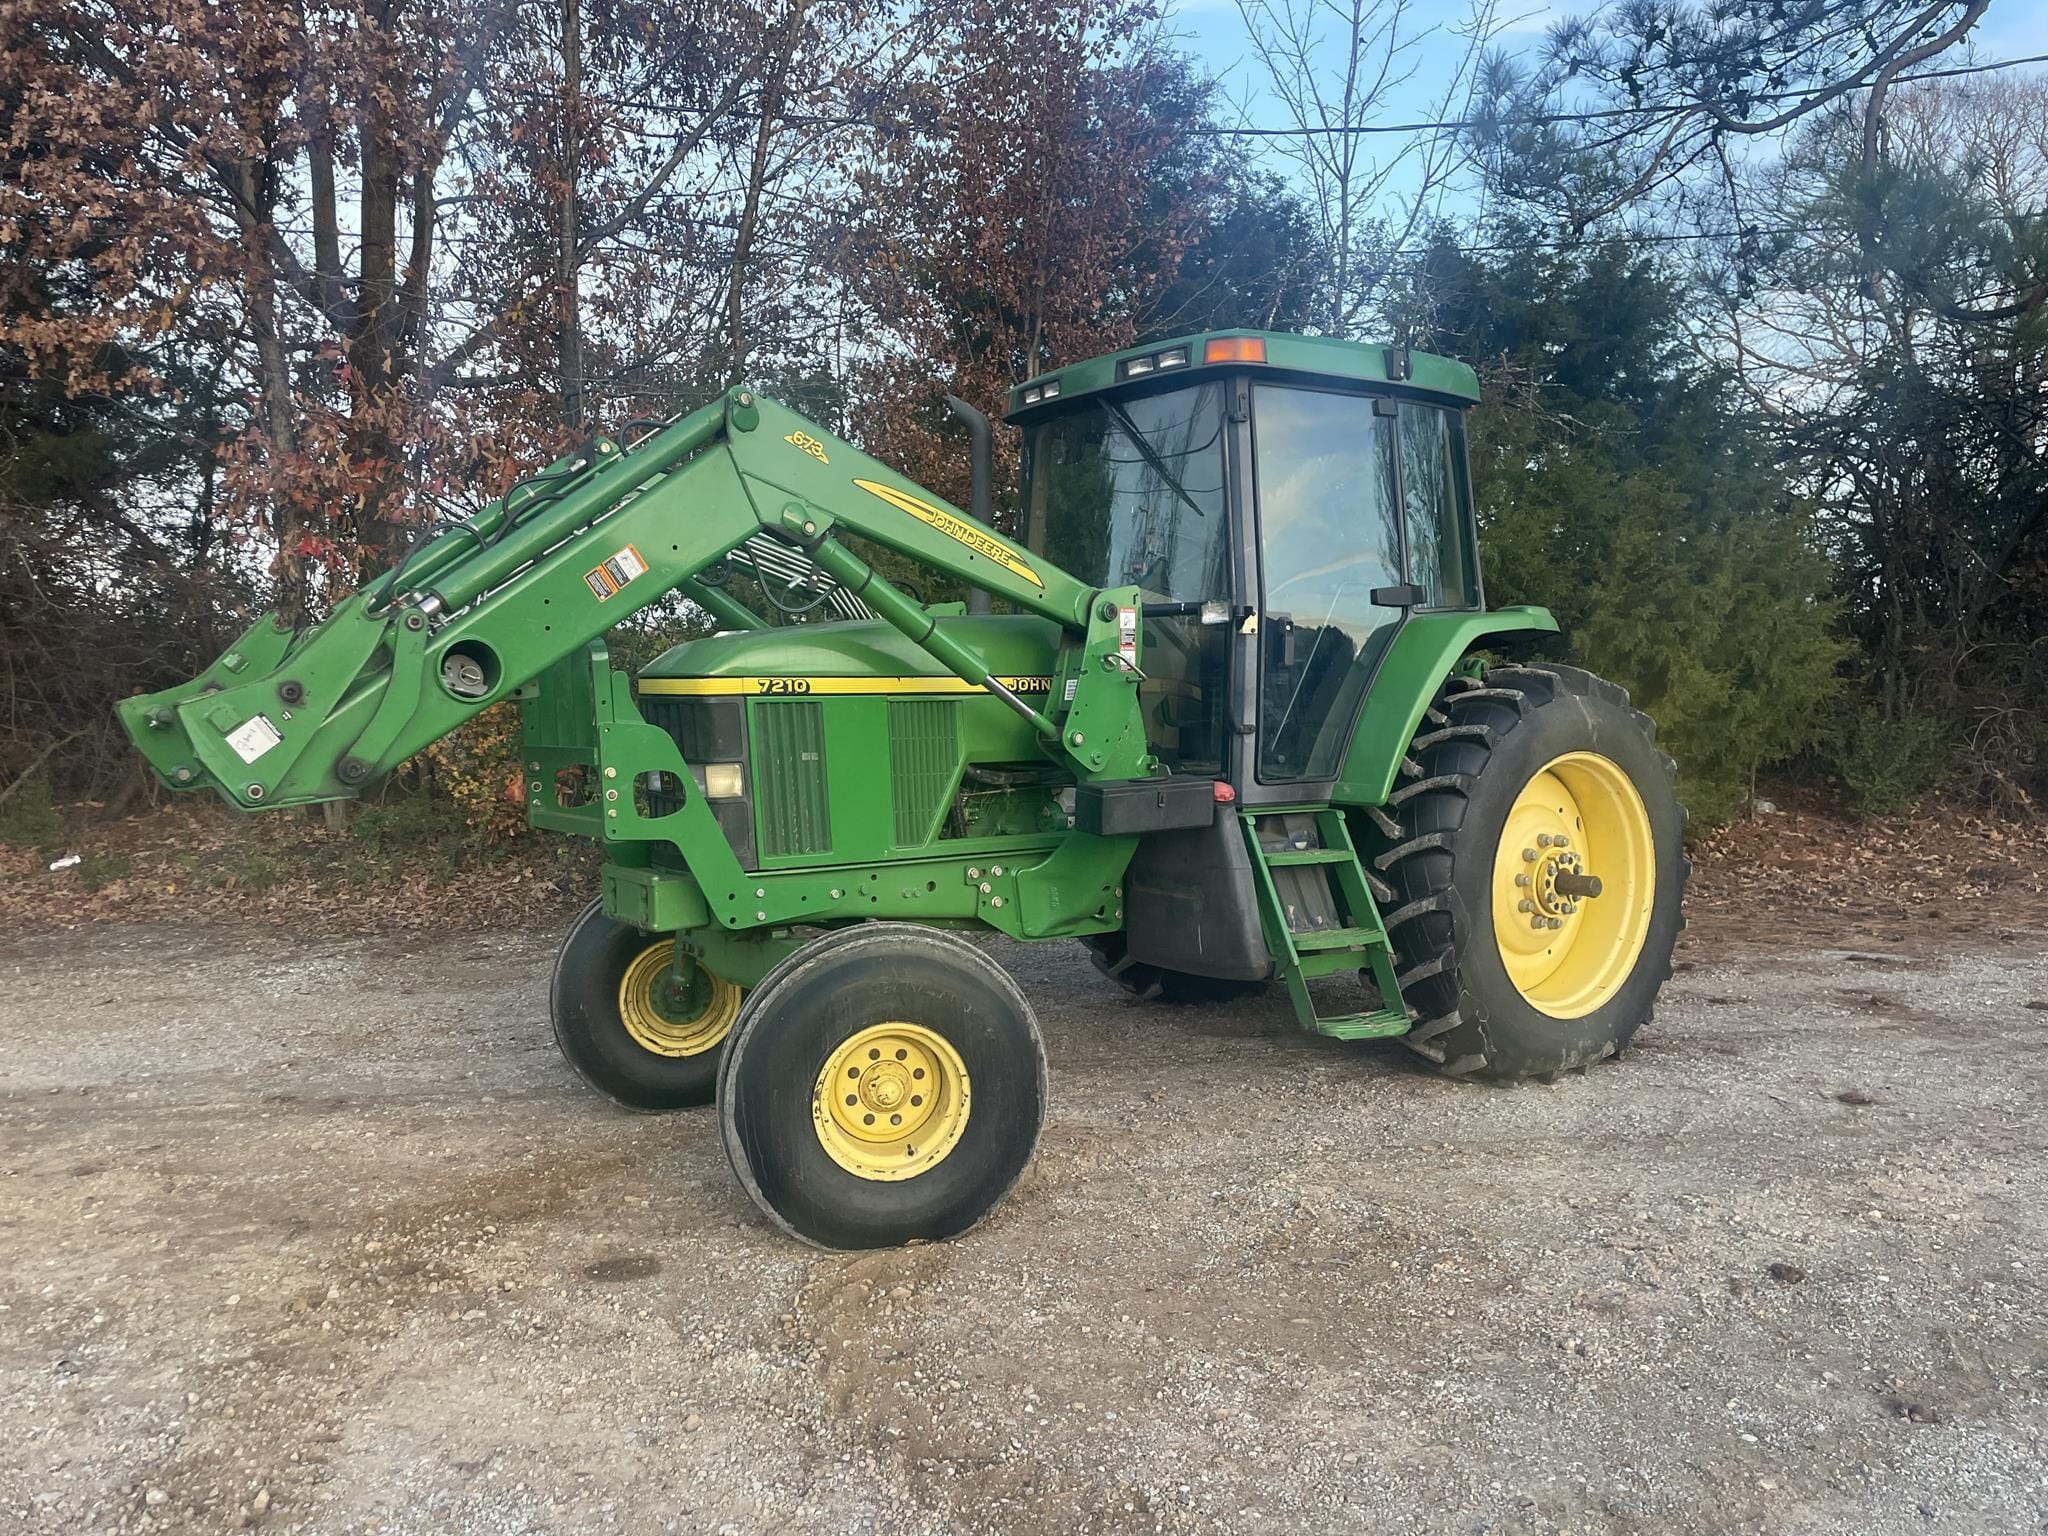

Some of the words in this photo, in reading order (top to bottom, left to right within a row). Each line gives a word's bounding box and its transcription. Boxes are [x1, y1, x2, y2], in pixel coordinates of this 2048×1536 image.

[793, 430, 824, 457] 673
[758, 679, 810, 693] 7210
[1007, 679, 1051, 692] JOHN
